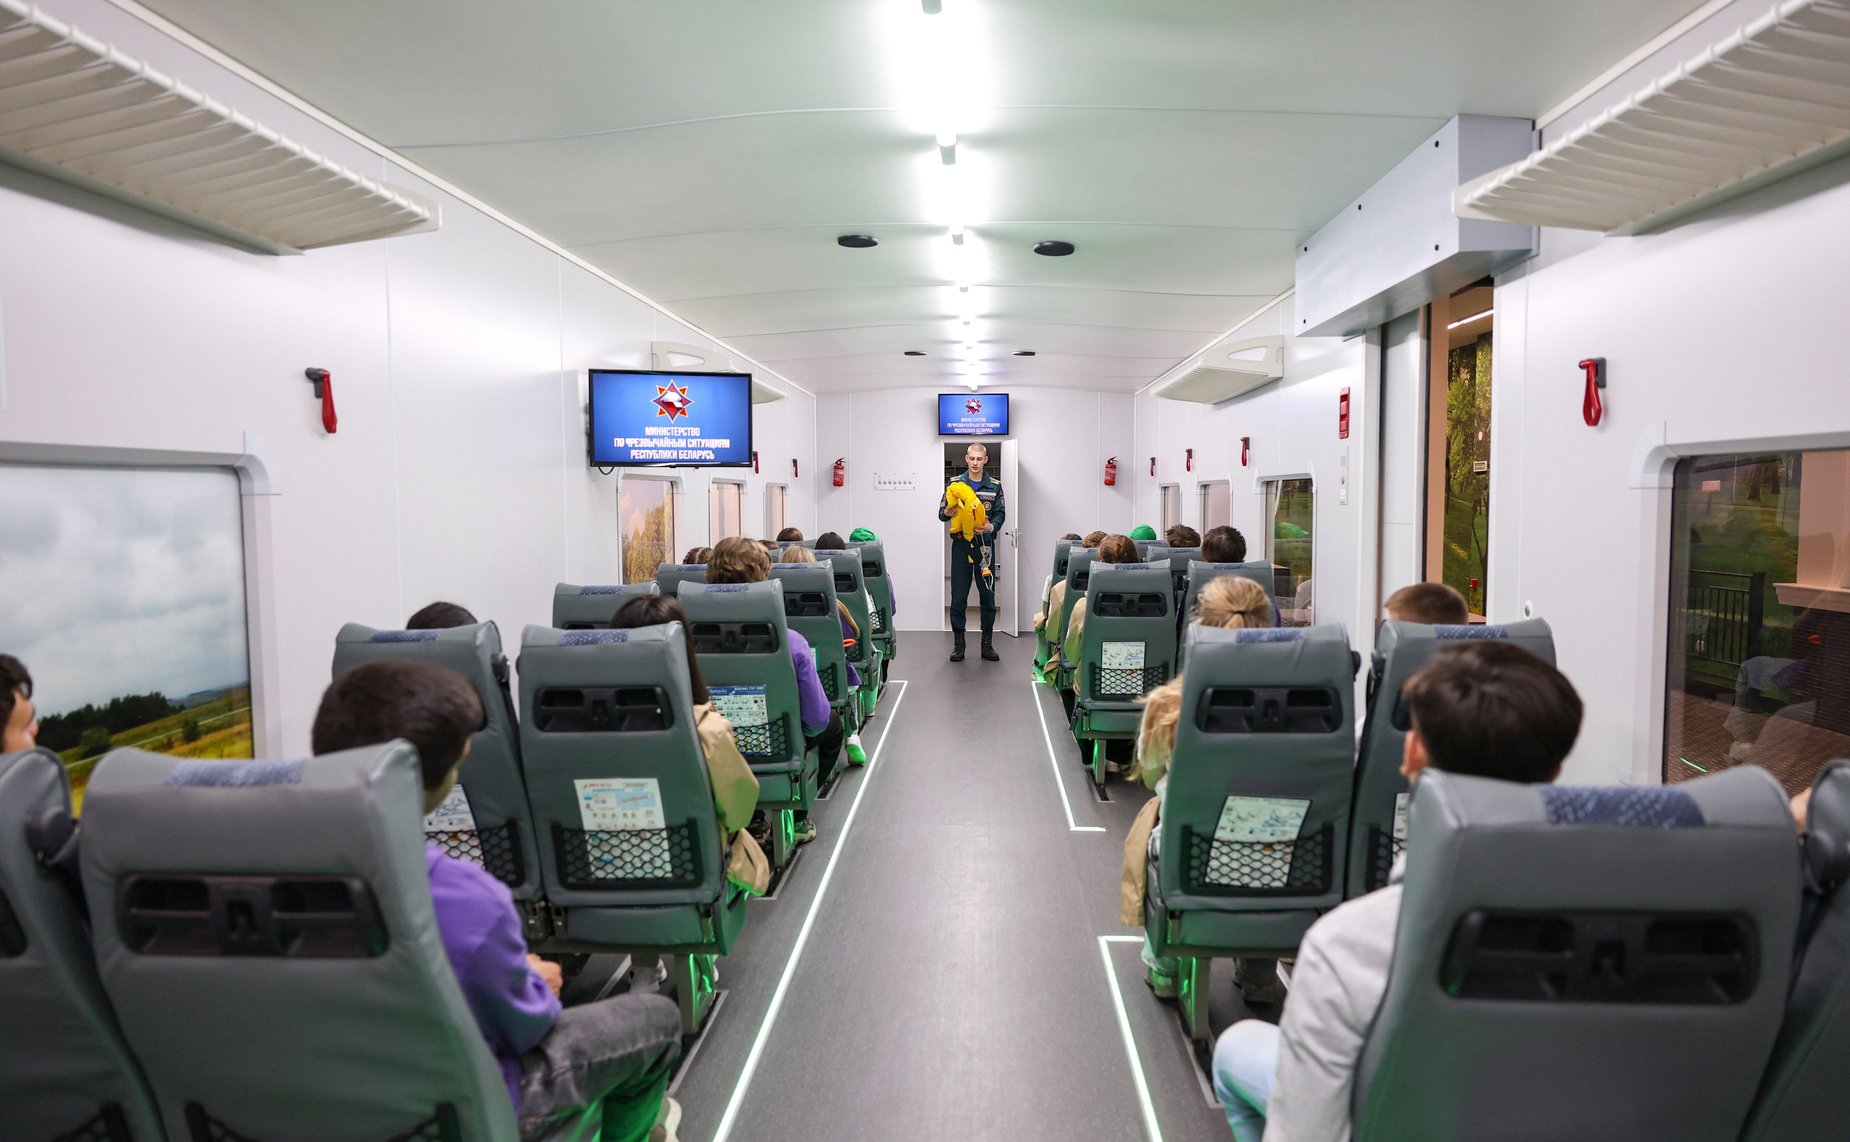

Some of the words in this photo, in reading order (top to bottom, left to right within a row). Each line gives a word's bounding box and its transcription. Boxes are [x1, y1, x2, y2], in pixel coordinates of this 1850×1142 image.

[645, 427, 700, 436] МИНИСТЕРСТВО
[614, 438, 625, 447] ПО
[625, 437, 687, 448] ЧРЕЗВЫЧАЙНЫМ
[687, 439, 730, 449] СИТУАЦИЯМ
[630, 449, 677, 459] РЕСПУБЛИКИ
[678, 450, 715, 460] БЕЛАРУСЬ
